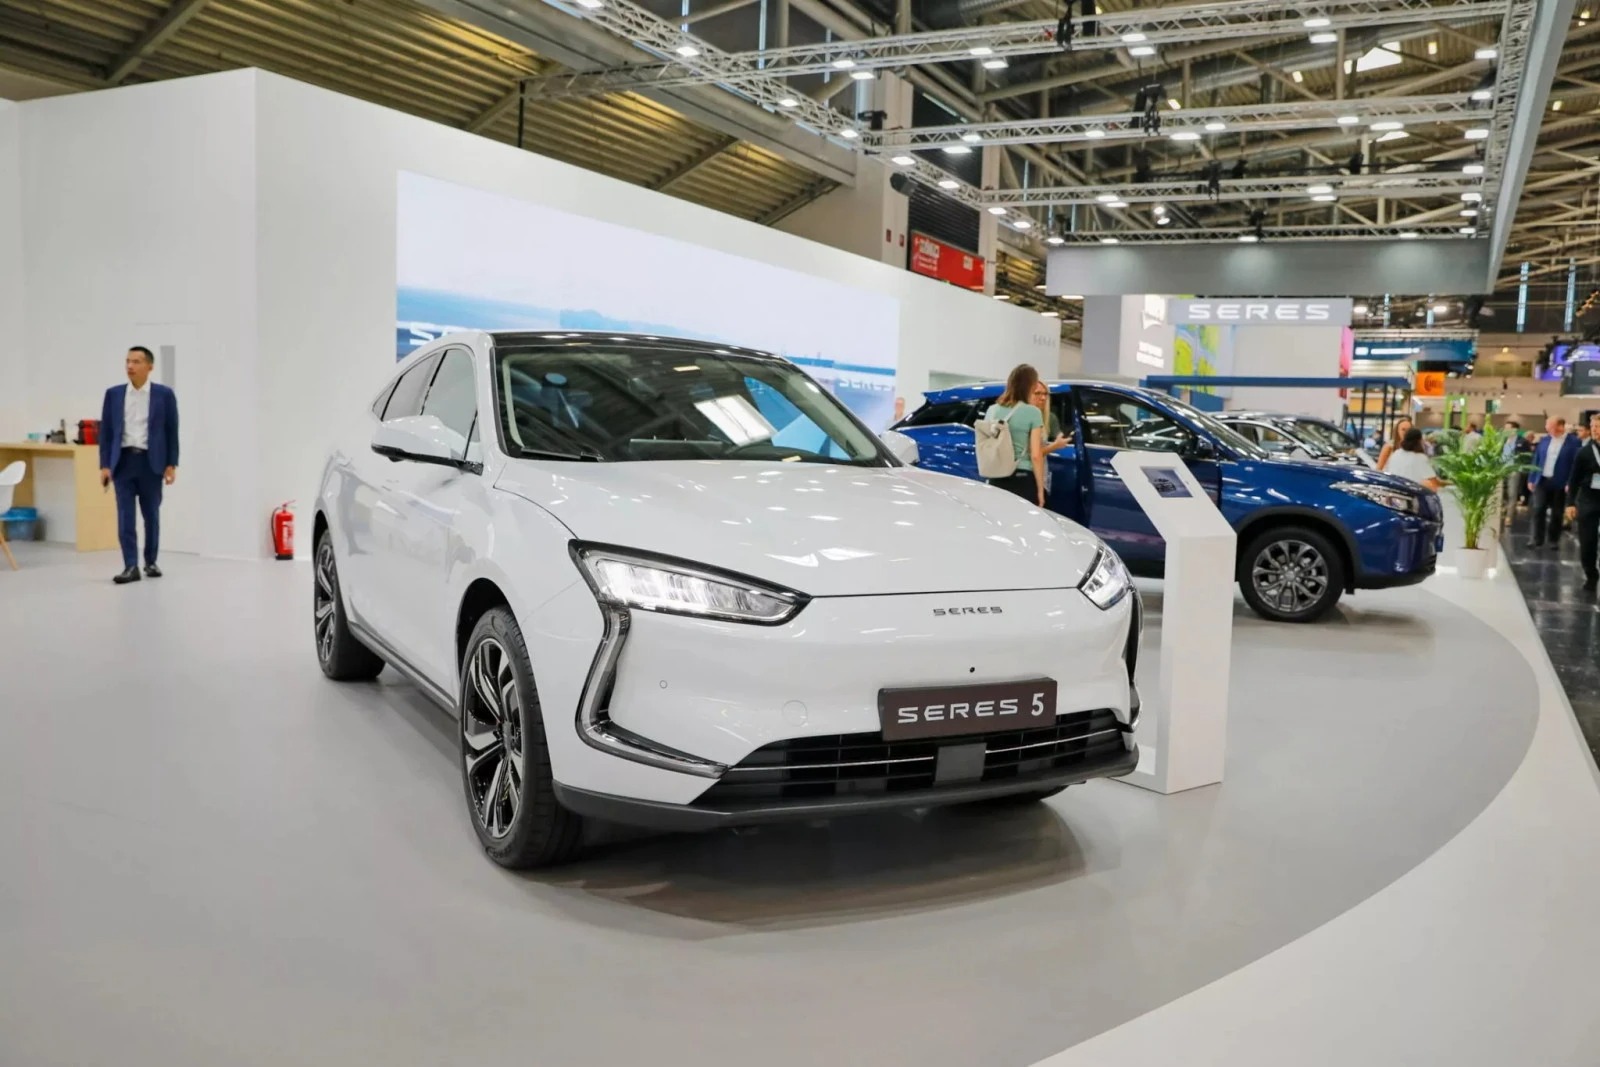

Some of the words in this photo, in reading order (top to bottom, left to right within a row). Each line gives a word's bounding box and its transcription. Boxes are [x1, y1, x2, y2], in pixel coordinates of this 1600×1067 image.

[1188, 303, 1330, 320] SERES
[933, 606, 1003, 616] SERES
[897, 698, 1019, 724] SERES
[1031, 692, 1045, 717] 5
